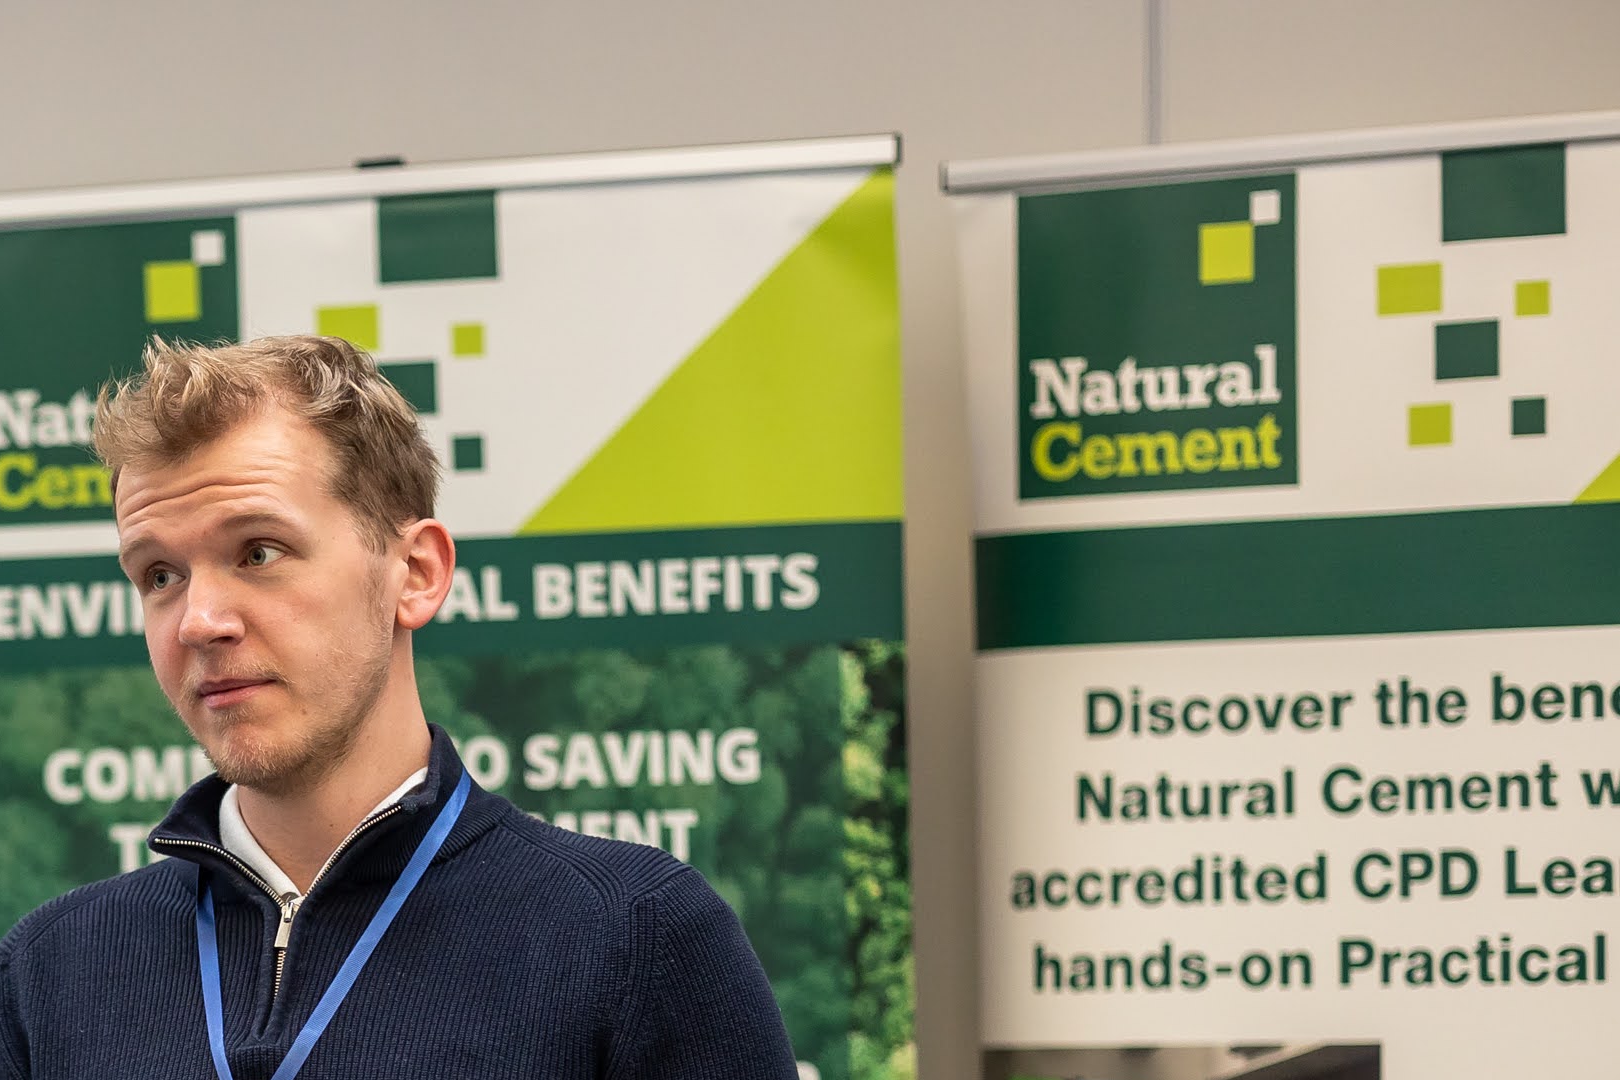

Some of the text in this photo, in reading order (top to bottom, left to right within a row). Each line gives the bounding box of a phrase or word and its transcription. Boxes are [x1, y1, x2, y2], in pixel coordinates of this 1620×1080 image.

[1030, 344, 1281, 418] Natural
[1030, 415, 1281, 481] Cement
[532, 552, 821, 619] BENEFITS
[1085, 686, 1354, 738] Discover
[1375, 676, 1468, 726] the
[524, 727, 762, 791] SAVING
[1076, 768, 1296, 822] Natural
[1321, 762, 1558, 815] Cement
[1010, 847, 1620, 910] accredited CPD Lea
[1034, 933, 1608, 991] hands-on Practical
